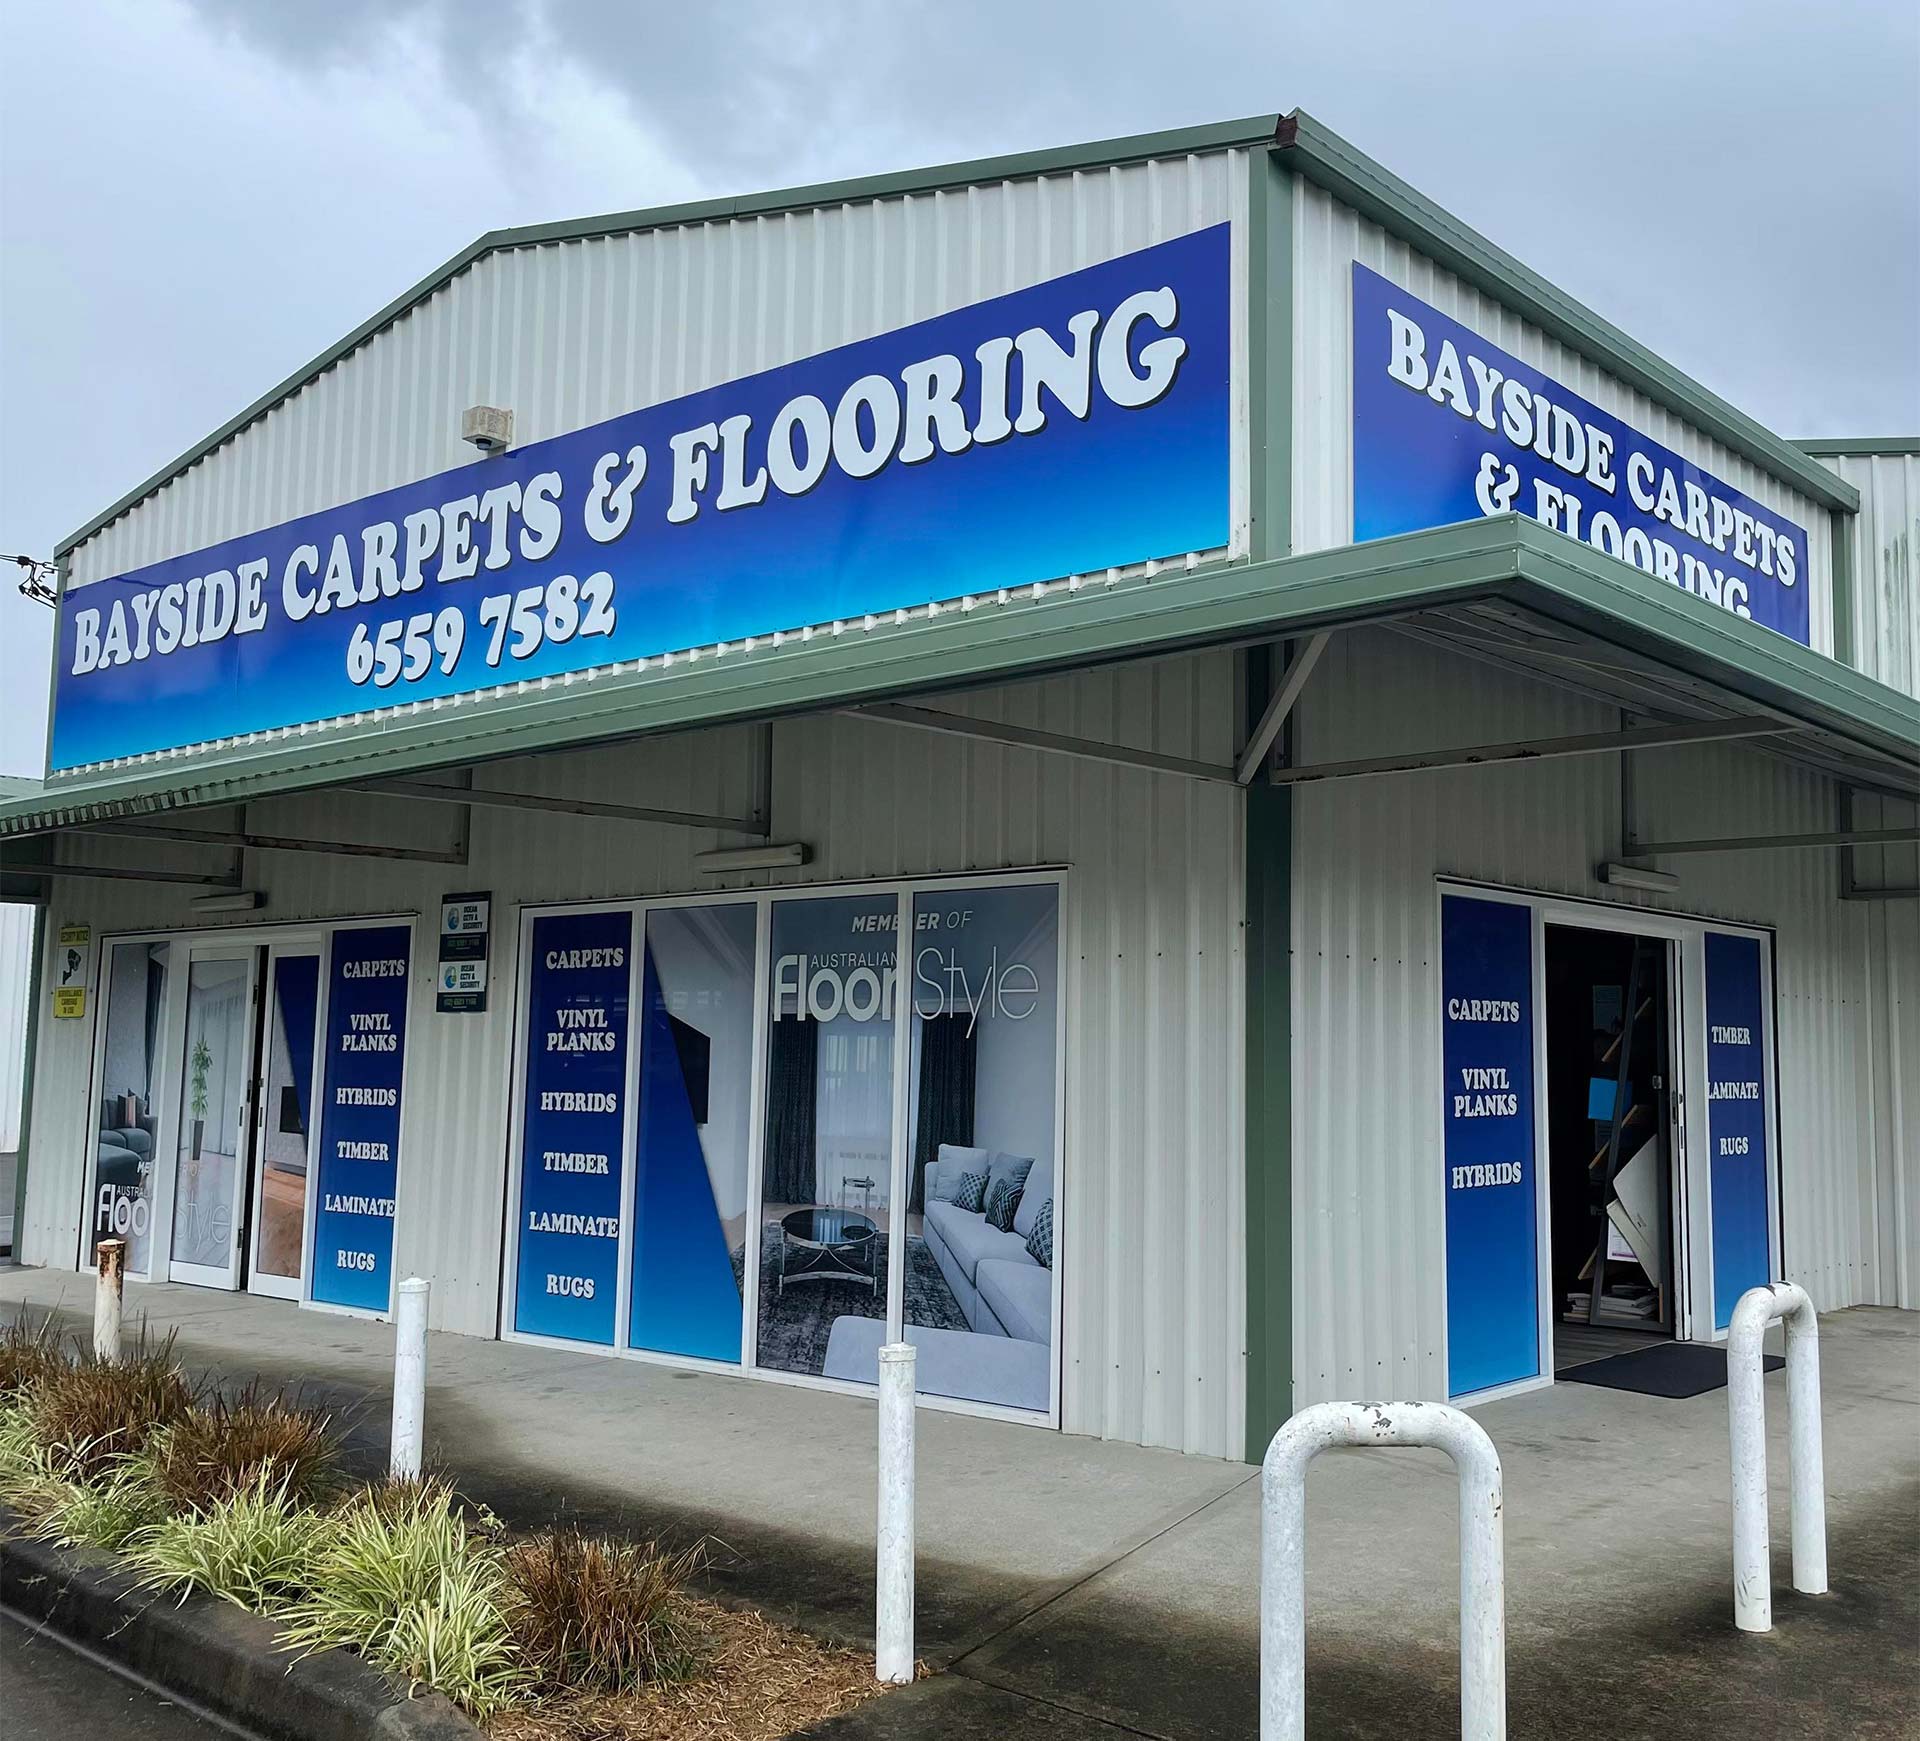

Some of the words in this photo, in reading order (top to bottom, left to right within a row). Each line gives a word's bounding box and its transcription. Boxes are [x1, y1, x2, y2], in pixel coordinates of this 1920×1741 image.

[1386, 307, 1617, 494] BAYSIDE
[1627, 450, 1797, 586] CARPETS
[72, 557, 270, 677] BAYSIDE
[281, 471, 563, 622] CARPETS
[583, 445, 648, 544] &
[666, 286, 1188, 525] FLOORING
[1475, 452, 1520, 516] &
[346, 606, 466, 688] 6559
[480, 571, 617, 666] 7582
[946, 910, 974, 929] OF
[342, 958, 406, 980] CARPETS
[546, 946, 625, 971] CARPETS
[810, 951, 898, 969] AUSTRALIAN
[349, 1012, 392, 1031] VINYL
[556, 1008, 609, 1029] VINYL
[1447, 997, 1521, 1024] CARPETS
[340, 1029, 398, 1053] PLANKS
[546, 1031, 617, 1053] PLANKS
[1711, 1024, 1752, 1046] TIMBER
[1461, 1067, 1511, 1090] VINYL
[1707, 1080, 1760, 1100] LAMINATE
[336, 1086, 397, 1108] HYBRIDS
[540, 1091, 618, 1114] HYBRIDS
[1453, 1094, 1518, 1119] PLANKS
[336, 1140, 390, 1162] TIMBER
[1718, 1135, 1750, 1157] RUGS
[543, 1150, 610, 1176] TIMBER
[1451, 1160, 1523, 1190] HYBRIDS
[324, 1193, 396, 1218] LAMINATE
[528, 1210, 619, 1239] LAMINATE
[336, 1248, 377, 1273] RUGS
[546, 1273, 596, 1300] RUGS
